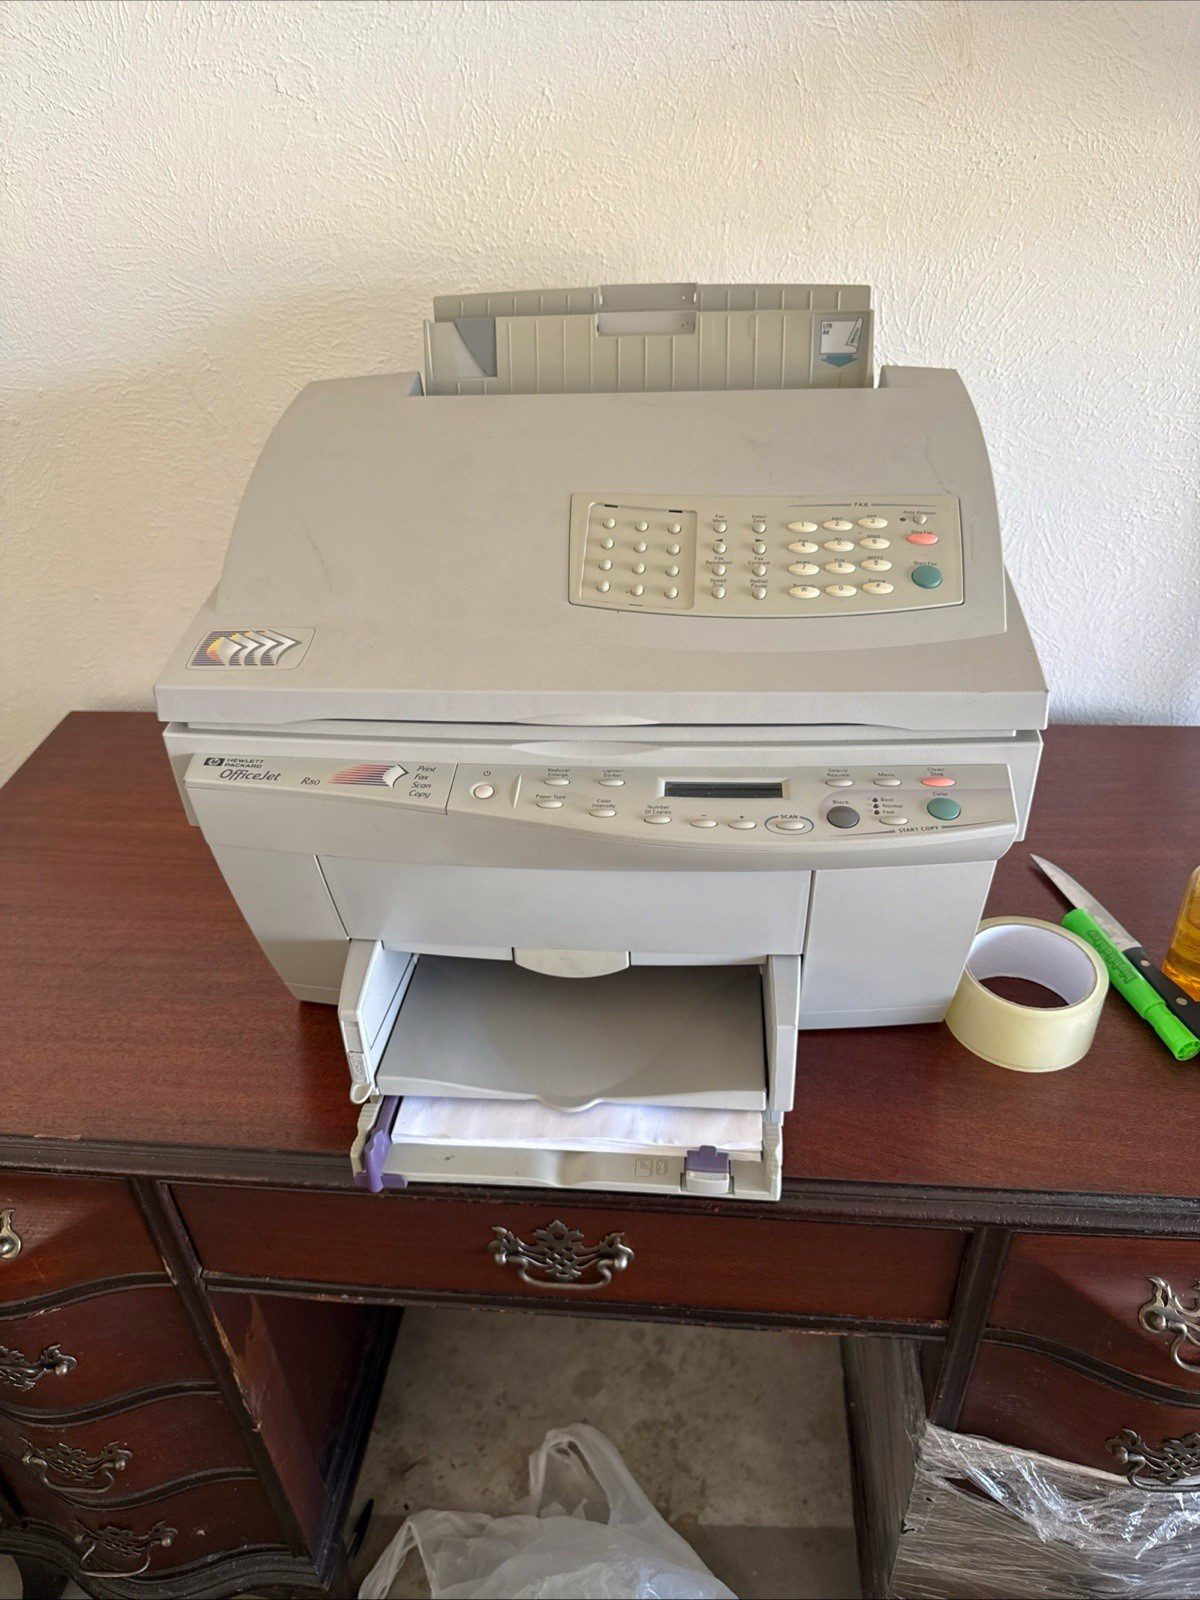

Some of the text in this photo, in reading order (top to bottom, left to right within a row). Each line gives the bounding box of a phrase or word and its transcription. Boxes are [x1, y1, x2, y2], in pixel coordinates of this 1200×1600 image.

[220, 769, 320, 786] OfficeJet R80
[408, 790, 431, 798] Copy
